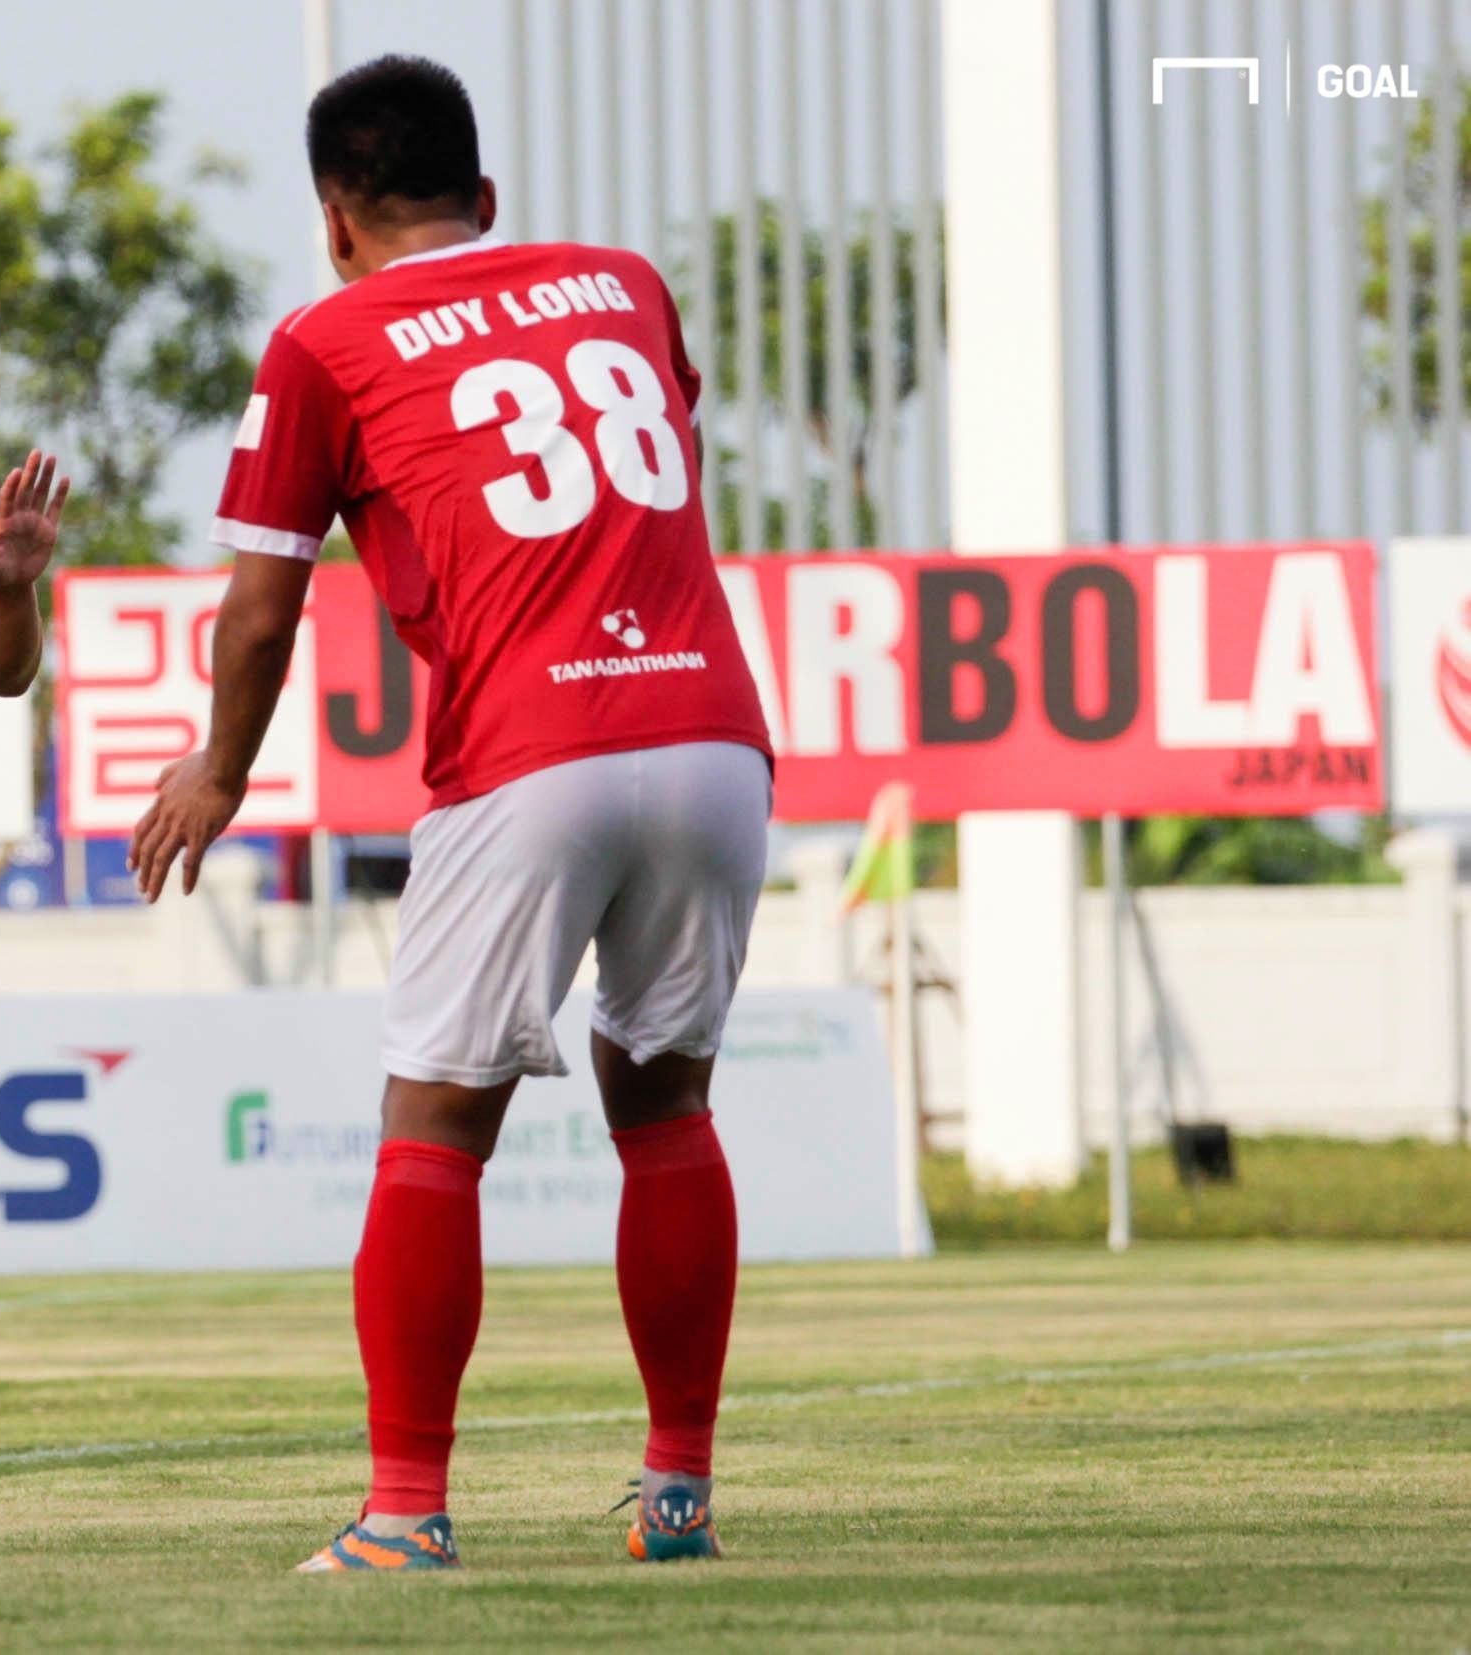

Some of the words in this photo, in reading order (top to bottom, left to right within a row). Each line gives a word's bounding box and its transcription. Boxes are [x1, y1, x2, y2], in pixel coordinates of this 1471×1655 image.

[385, 298, 492, 362] DUY
[498, 272, 635, 327] LONG
[450, 339, 689, 539] 38
[547, 652, 707, 684] TANADAITHANH
[1226, 748, 1371, 787] JAPAN
